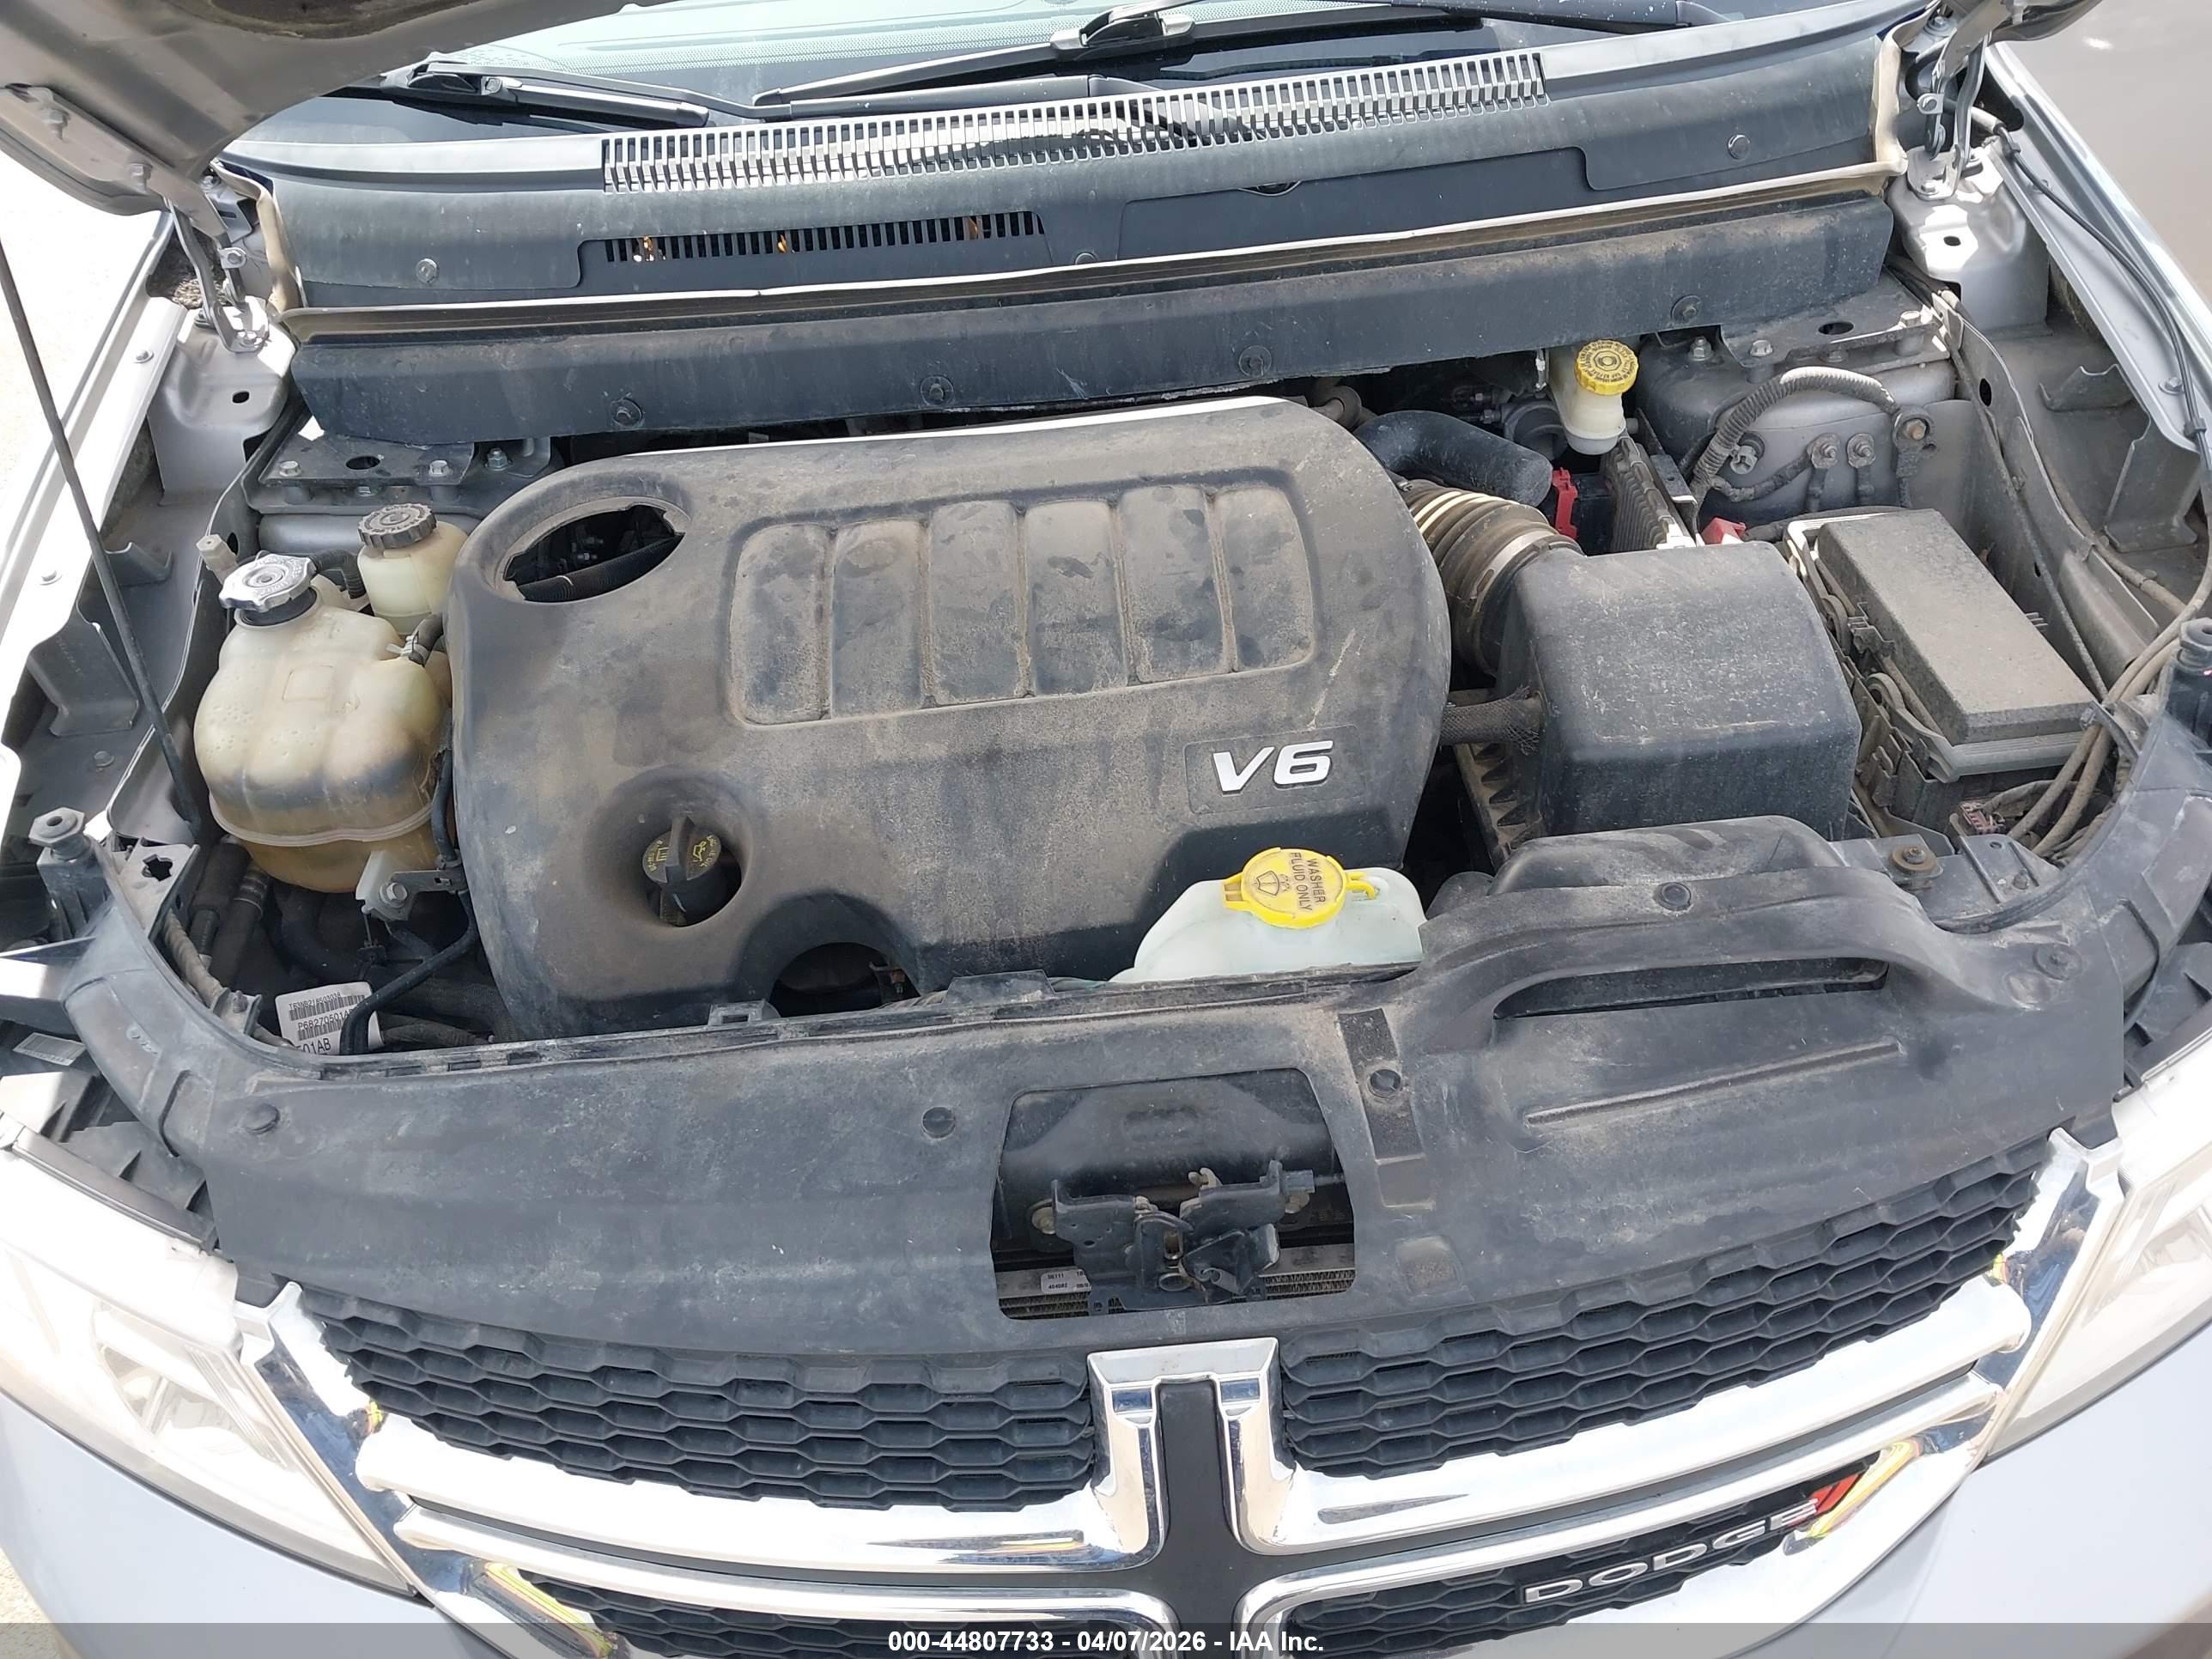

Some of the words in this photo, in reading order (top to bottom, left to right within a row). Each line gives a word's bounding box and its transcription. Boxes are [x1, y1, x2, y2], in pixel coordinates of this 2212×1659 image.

[1212, 740, 1334, 793] V6
[1290, 852, 1306, 883] FLUID
[1306, 858, 1327, 903] WASHER
[1296, 884, 1313, 911] ONLY
[295, 1037, 331, 1054] 01AB
[1525, 1498, 1819, 1603] DODGE
